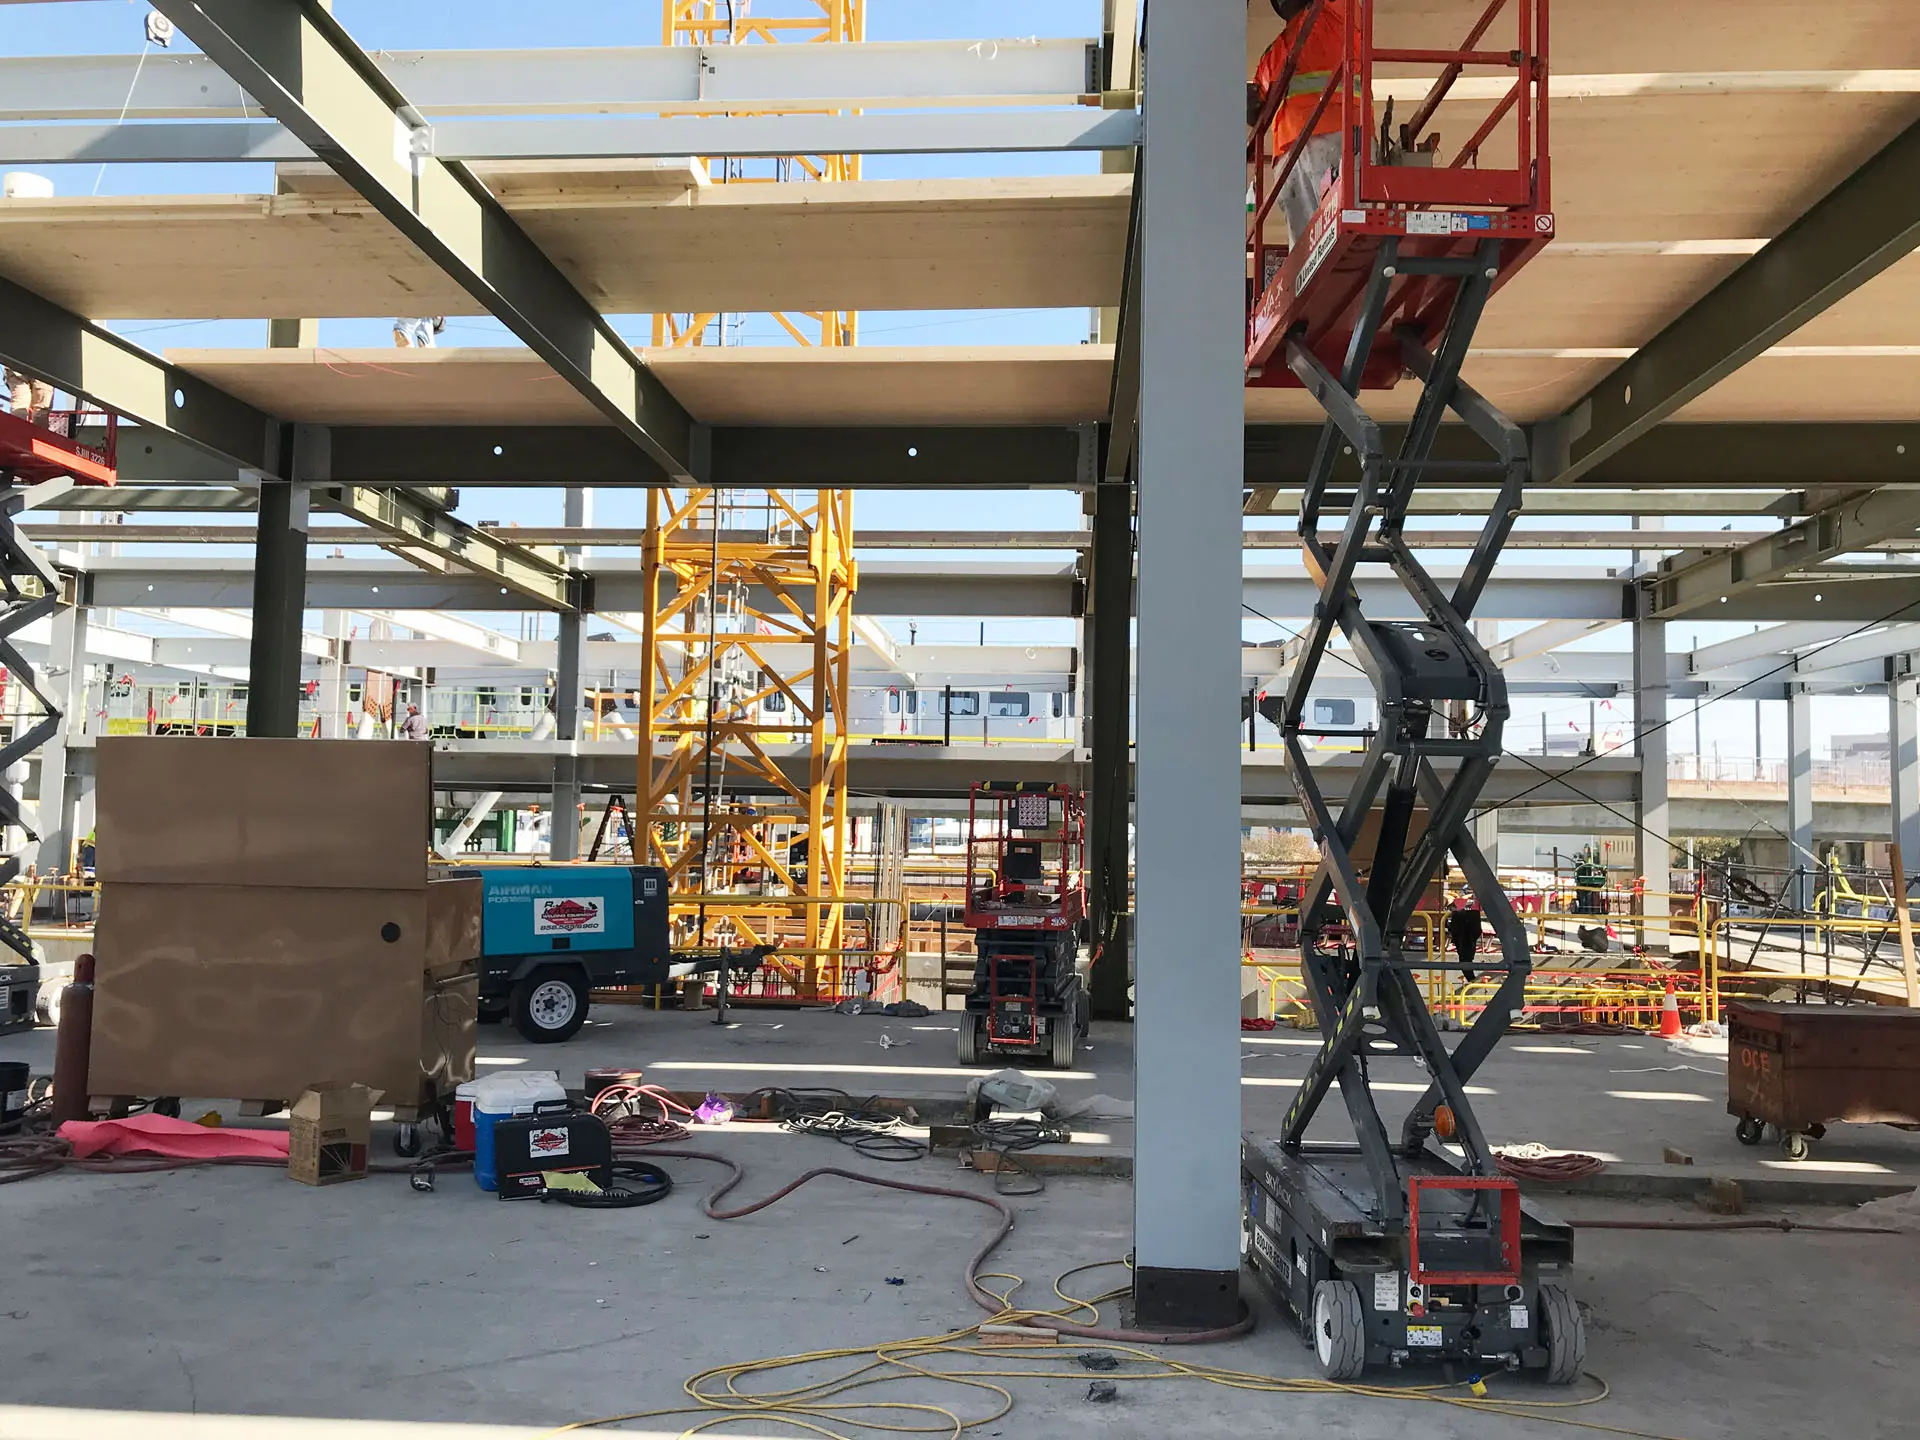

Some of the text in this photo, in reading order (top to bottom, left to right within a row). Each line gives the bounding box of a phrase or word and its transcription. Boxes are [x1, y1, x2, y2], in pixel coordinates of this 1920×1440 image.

[1302, 228, 1335, 281] United Rentals
[90, 452, 105, 465] 3226
[1265, 1170, 1292, 1208] SKYJACK
